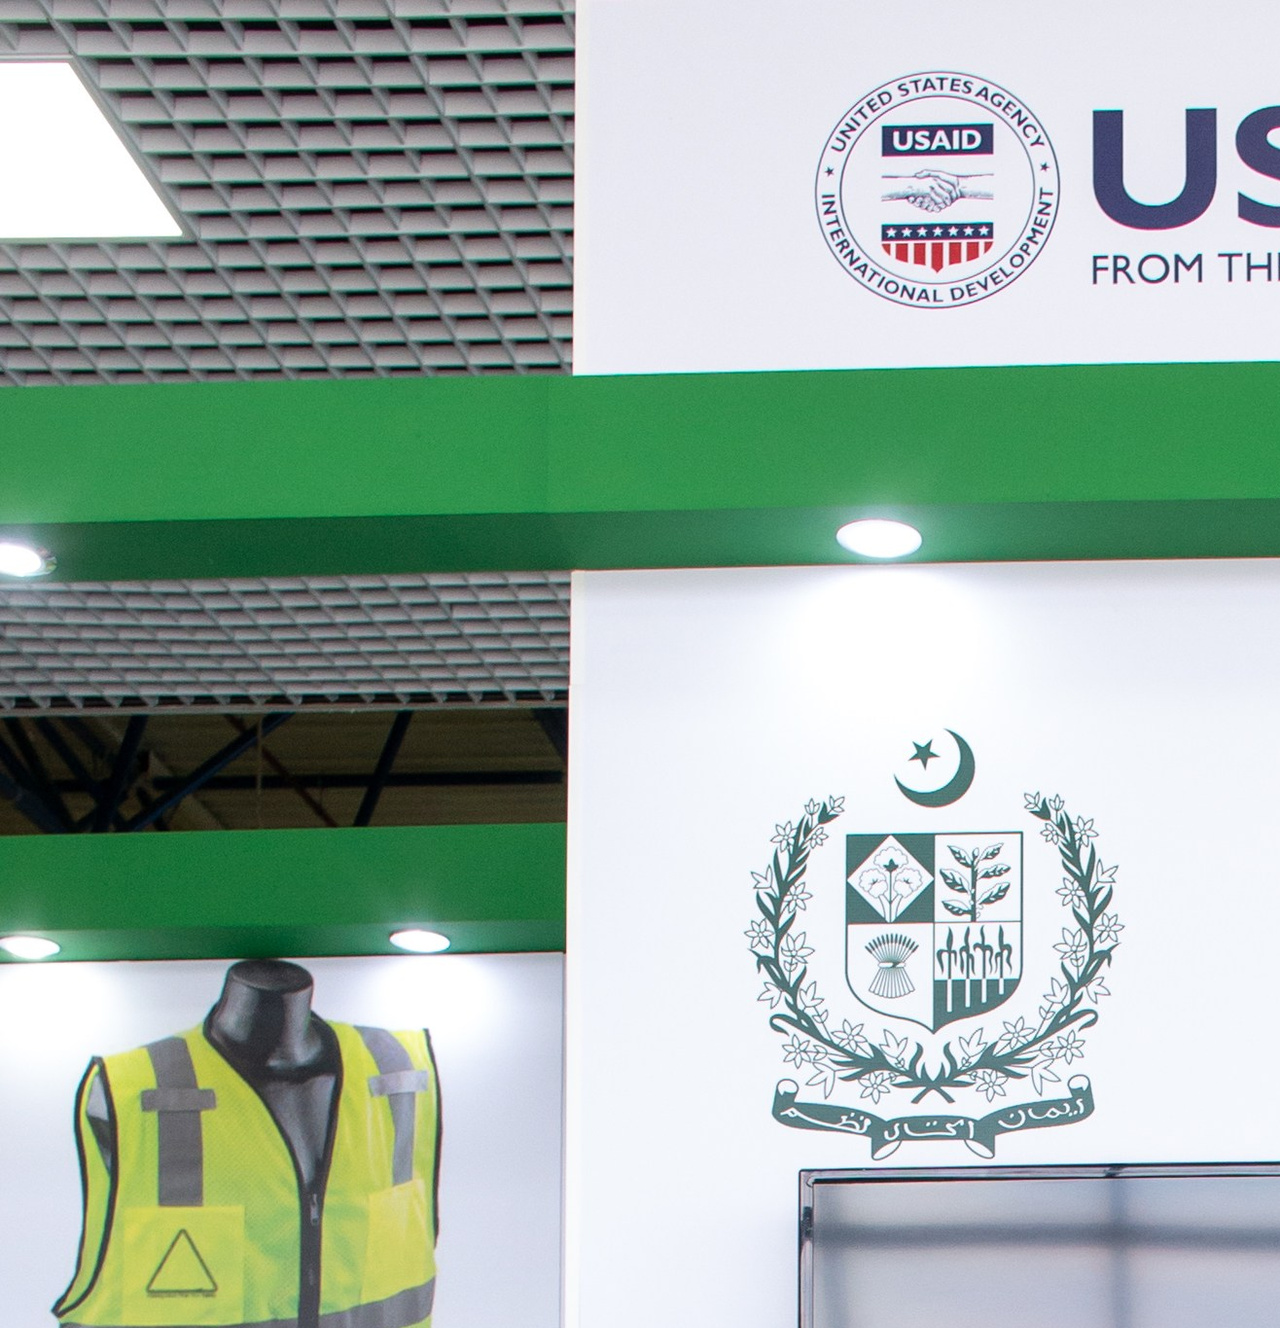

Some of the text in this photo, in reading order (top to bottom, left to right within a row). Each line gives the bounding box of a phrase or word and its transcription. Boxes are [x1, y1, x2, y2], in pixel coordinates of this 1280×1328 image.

[831, 77, 1045, 153] UNITED STATES AGENCY
[892, 129, 982, 152] USAID
[822, 187, 1054, 302] INTERNATIONAL DEVELOPMENT
[1092, 253, 1203, 284] FROM
